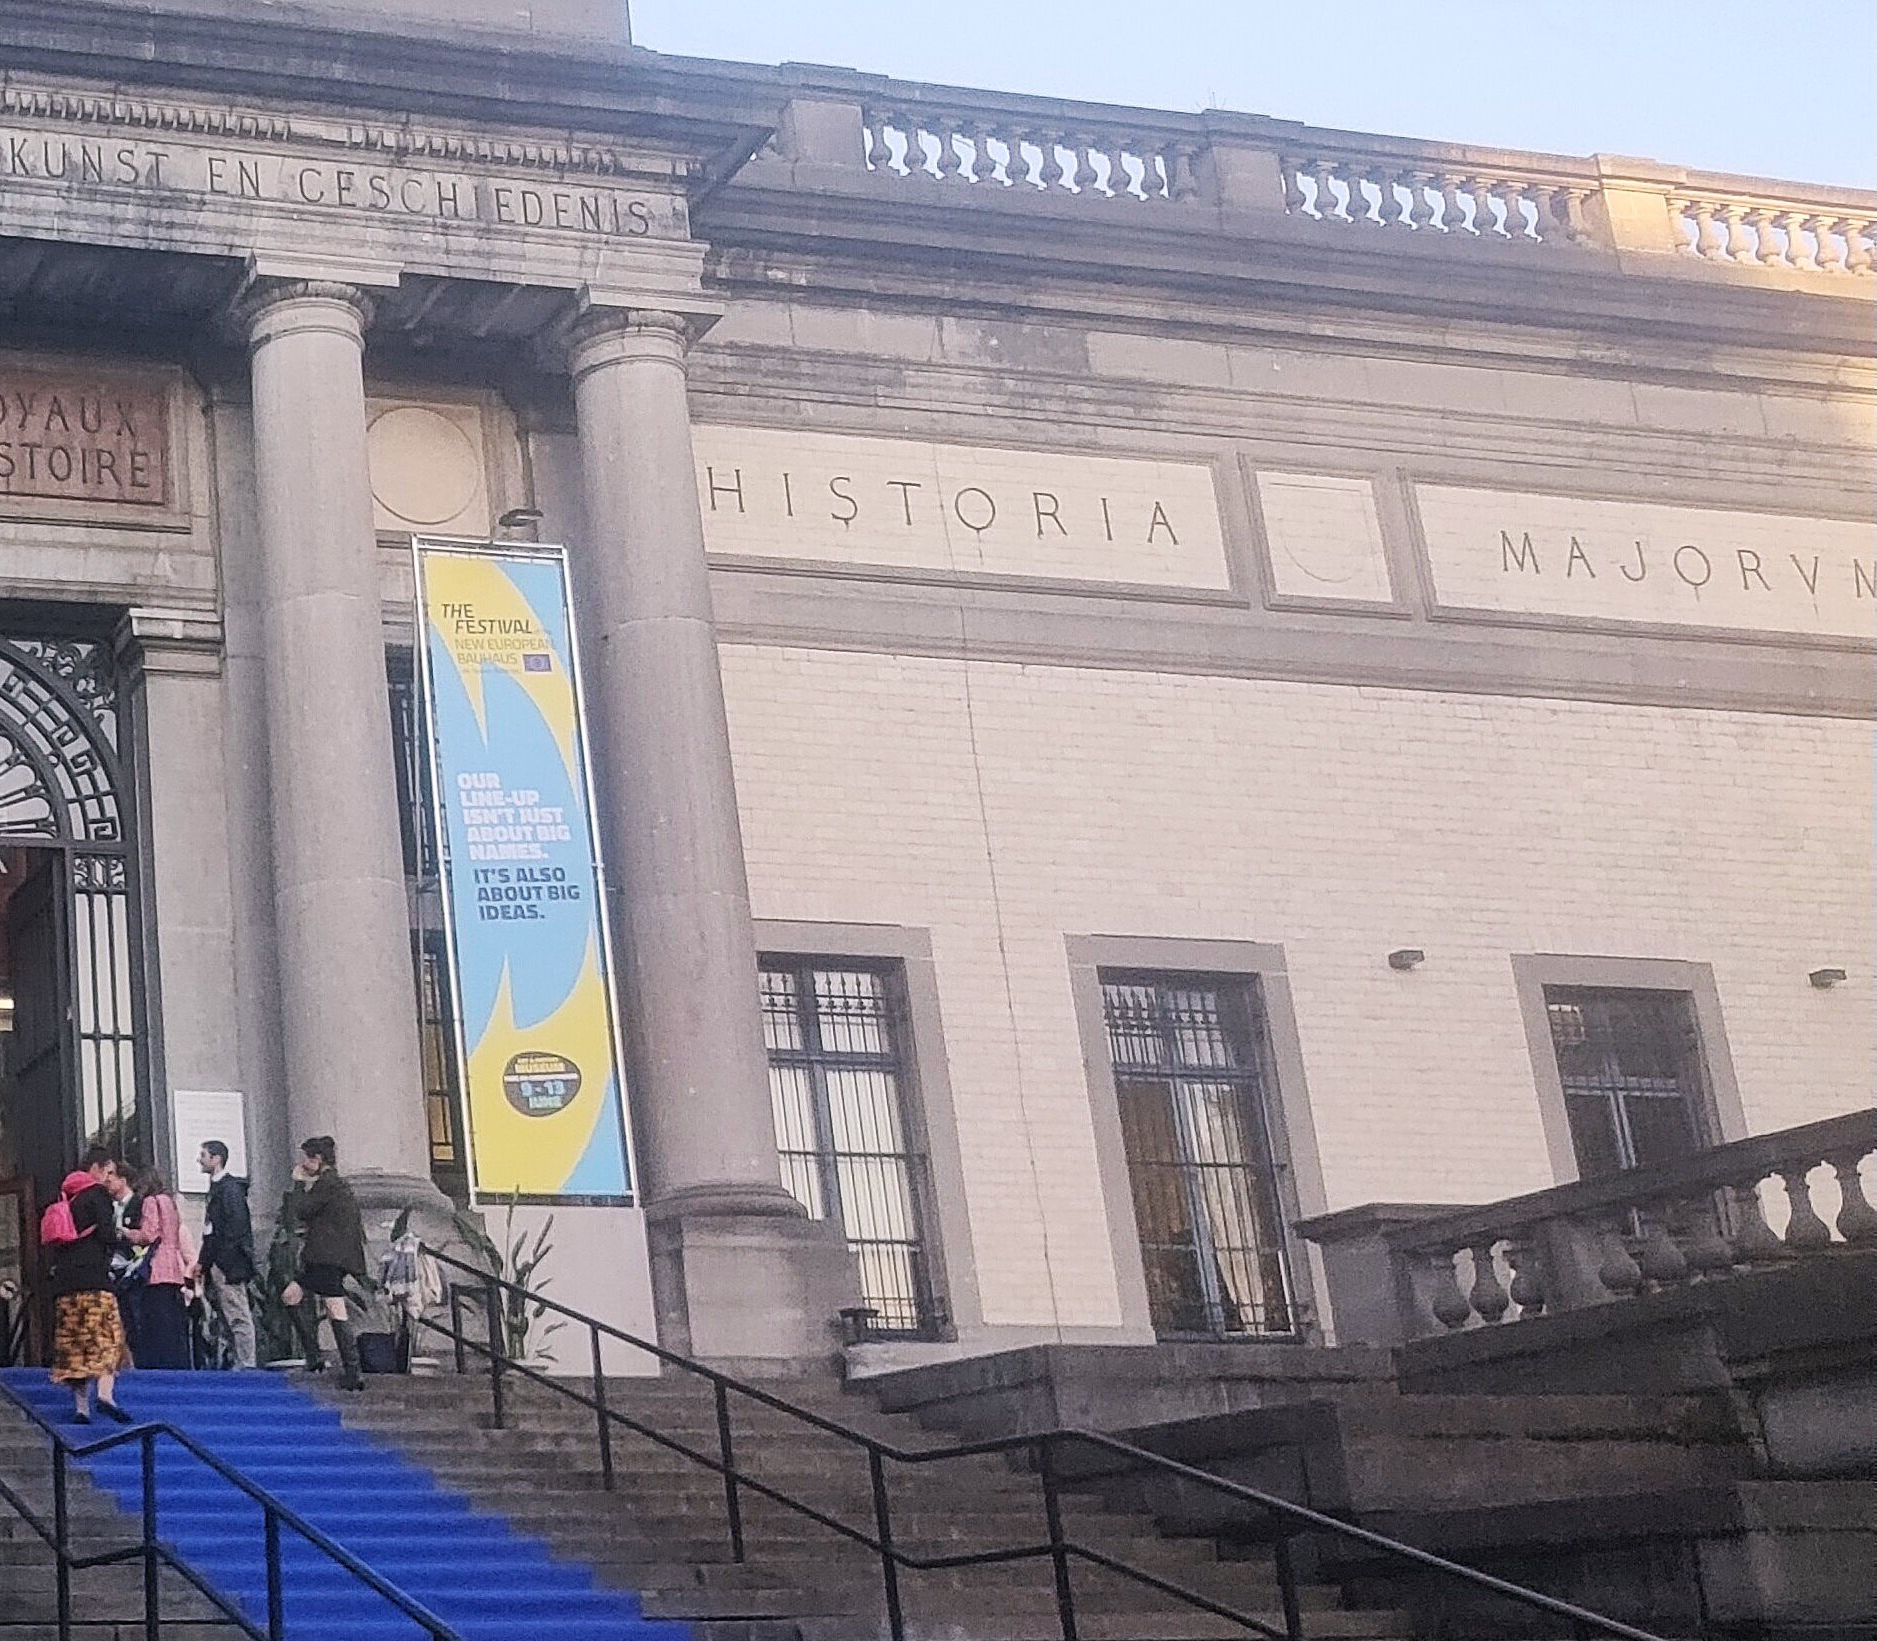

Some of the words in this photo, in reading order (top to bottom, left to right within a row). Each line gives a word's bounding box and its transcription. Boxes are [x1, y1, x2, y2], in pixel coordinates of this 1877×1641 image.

[9, 137, 170, 187] KUNST
[208, 158, 261, 198] EN
[299, 168, 650, 235] GESCHIEDENIS
[707, 467, 1180, 545] HISTORIA
[441, 603, 475, 618] THE
[455, 619, 532, 635] FESTIVAL
[454, 638, 484, 650] NEW
[457, 652, 518, 665] BAUHAUS
[457, 772, 501, 789] OUR
[459, 789, 540, 807] LINE-UP
[462, 808, 516, 825] ISN'T
[519, 806, 564, 823] JUST
[467, 825, 534, 843] ABOUT
[536, 824, 572, 841] BIG
[469, 842, 549, 861] NAMES.
[475, 868, 511, 885] IT'S
[516, 866, 566, 883] ALSO
[477, 885, 543, 902] ABOUT
[547, 884, 581, 900] BIG
[480, 904, 546, 921] IDEAS.
